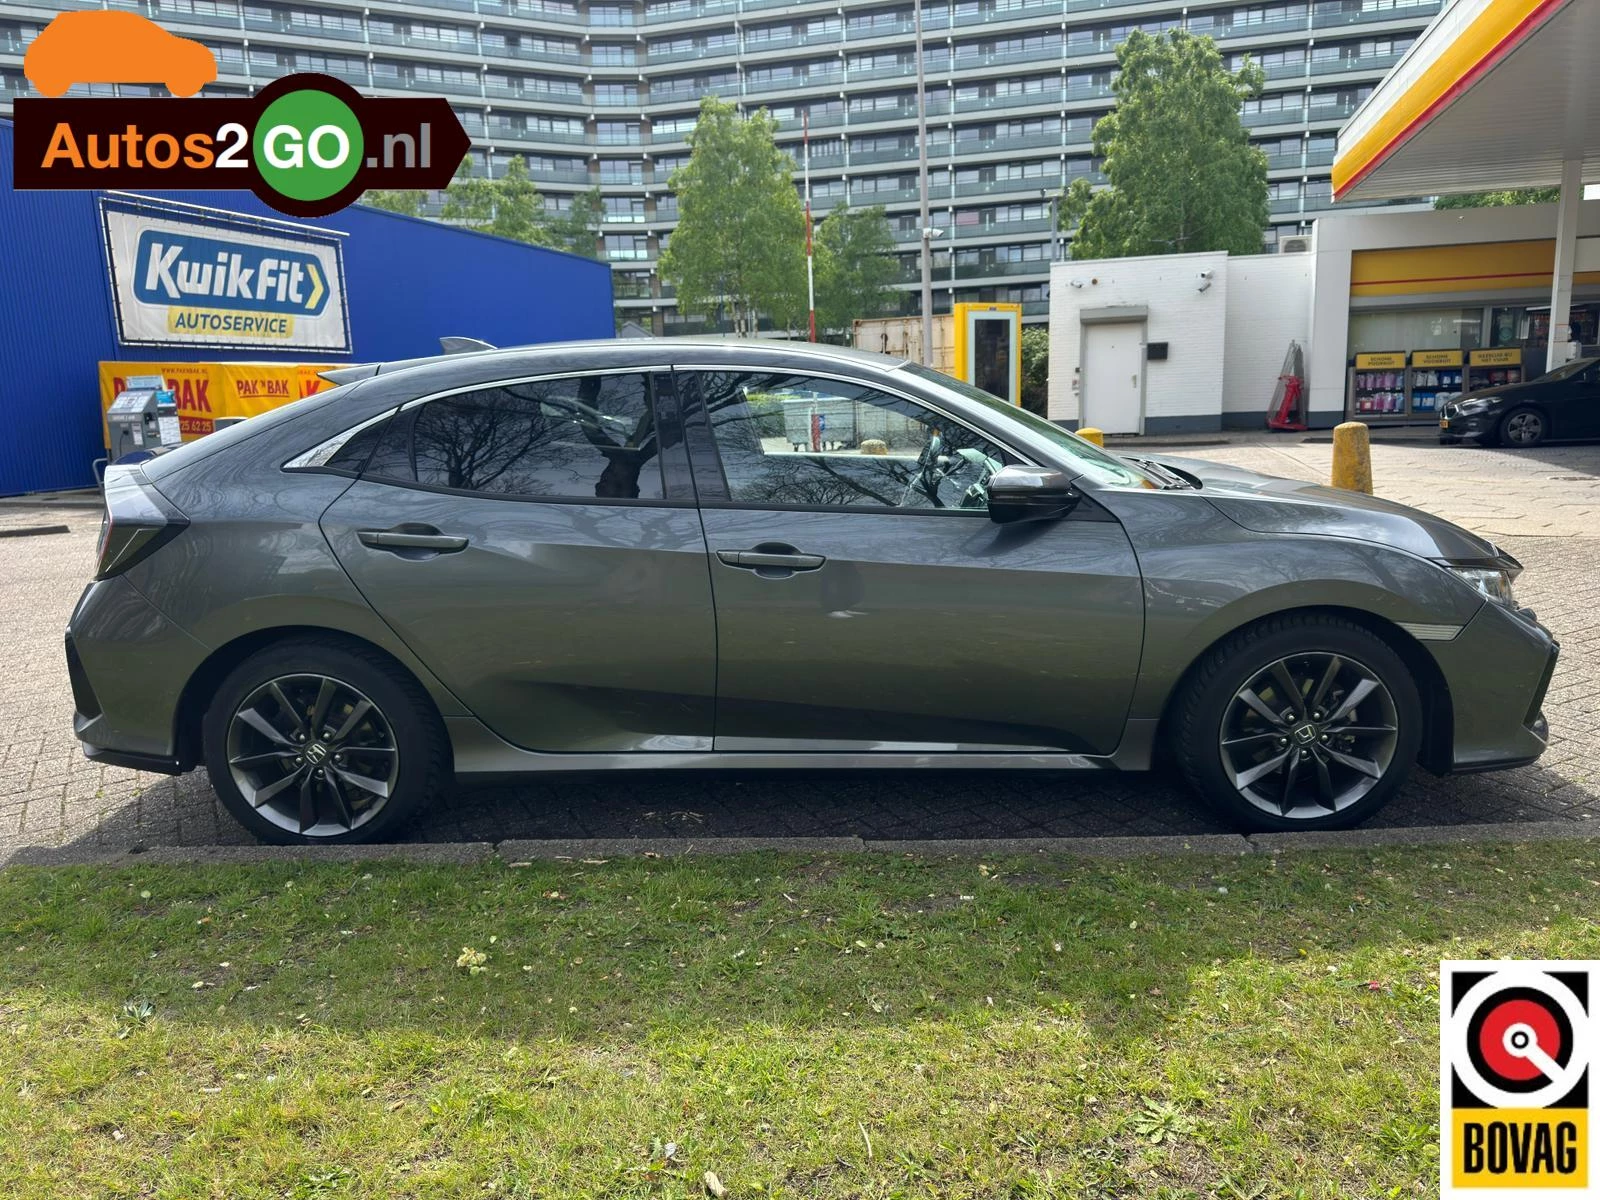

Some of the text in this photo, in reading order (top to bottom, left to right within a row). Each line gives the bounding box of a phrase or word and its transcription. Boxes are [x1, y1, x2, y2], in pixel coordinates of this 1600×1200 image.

[175, 312, 287, 333] AUTOSERVICE
[236, 379, 259, 395] PAK
[267, 379, 289, 394] BAK
[191, 420, 201, 432] 62
